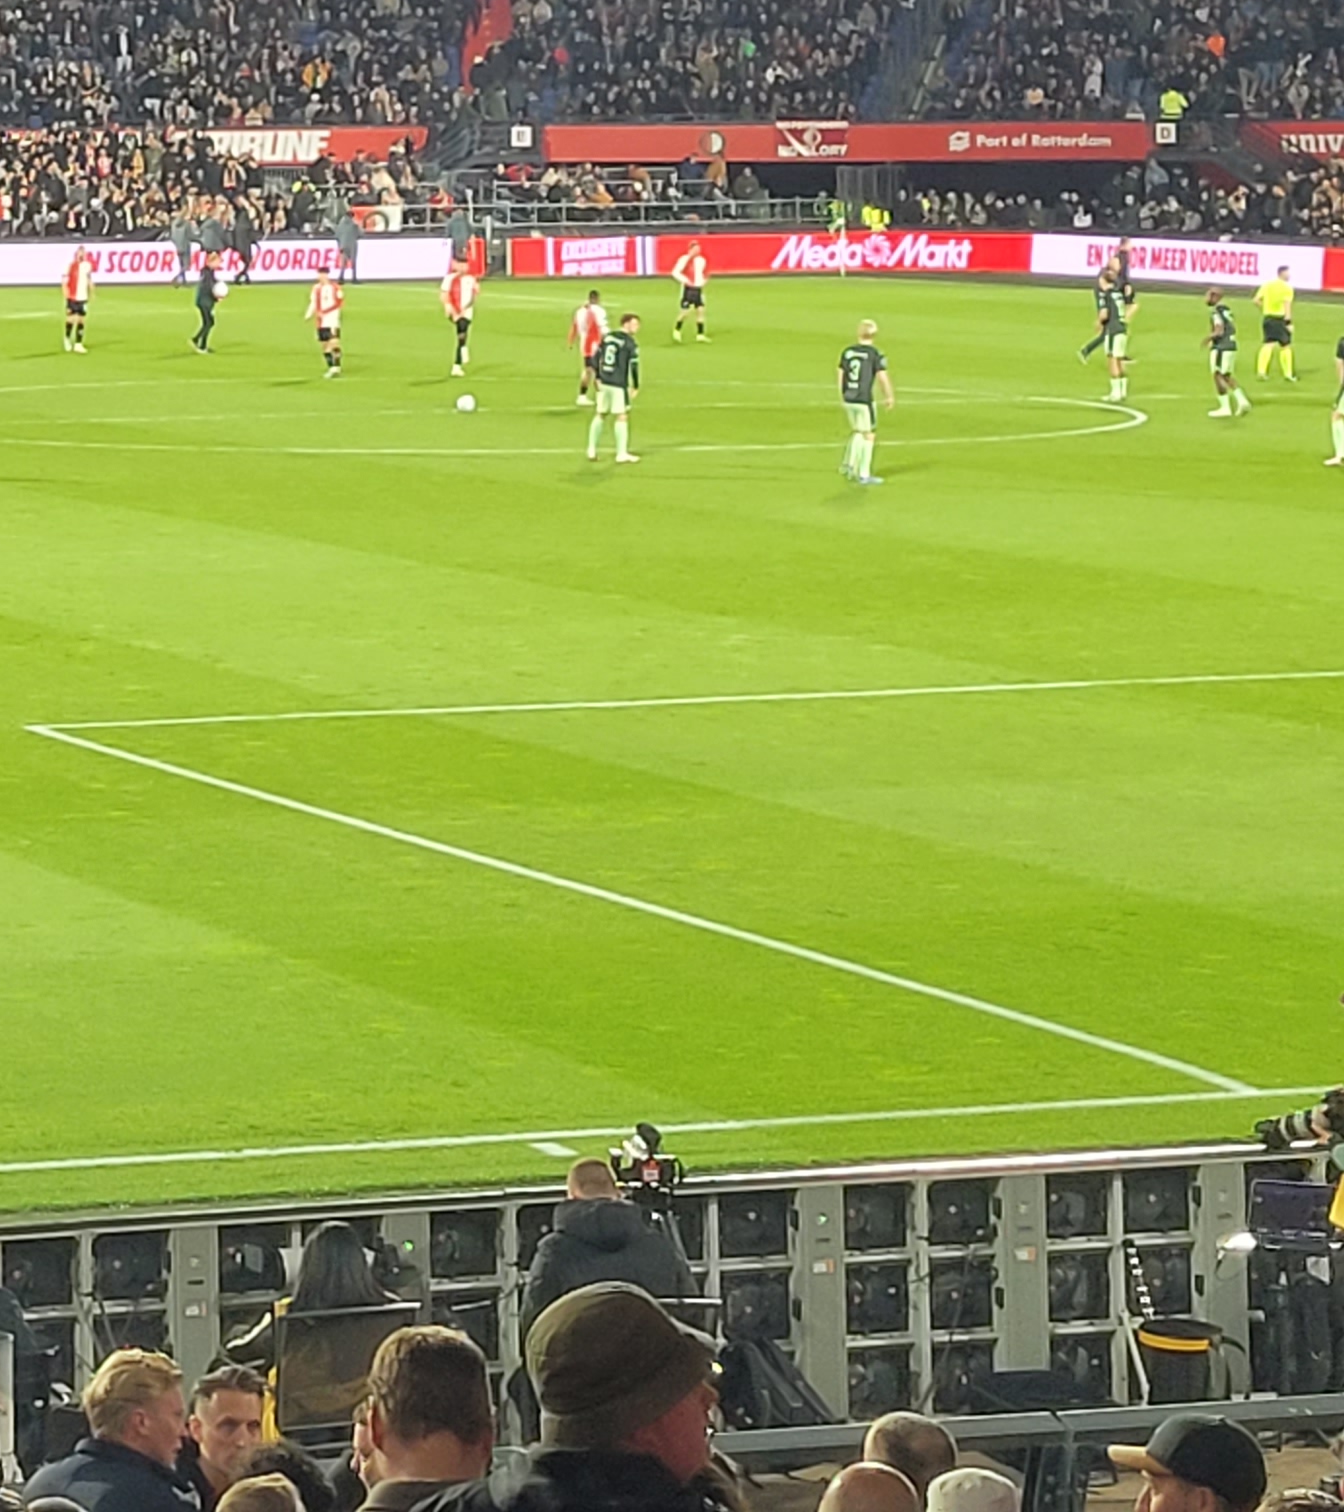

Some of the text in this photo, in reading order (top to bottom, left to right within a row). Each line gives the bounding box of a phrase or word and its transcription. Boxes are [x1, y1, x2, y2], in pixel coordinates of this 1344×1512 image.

[976, 132, 1111, 149] Port of Rotterdam
[1159, 126, 1172, 141] D
[105, 250, 174, 273] SCOOR
[1087, 244, 1103, 266] EN
[1150, 247, 1186, 272] MEER
[1189, 250, 1259, 276] VOORDEEL
[604, 344, 617, 366] 6
[849, 358, 861, 381] 3
